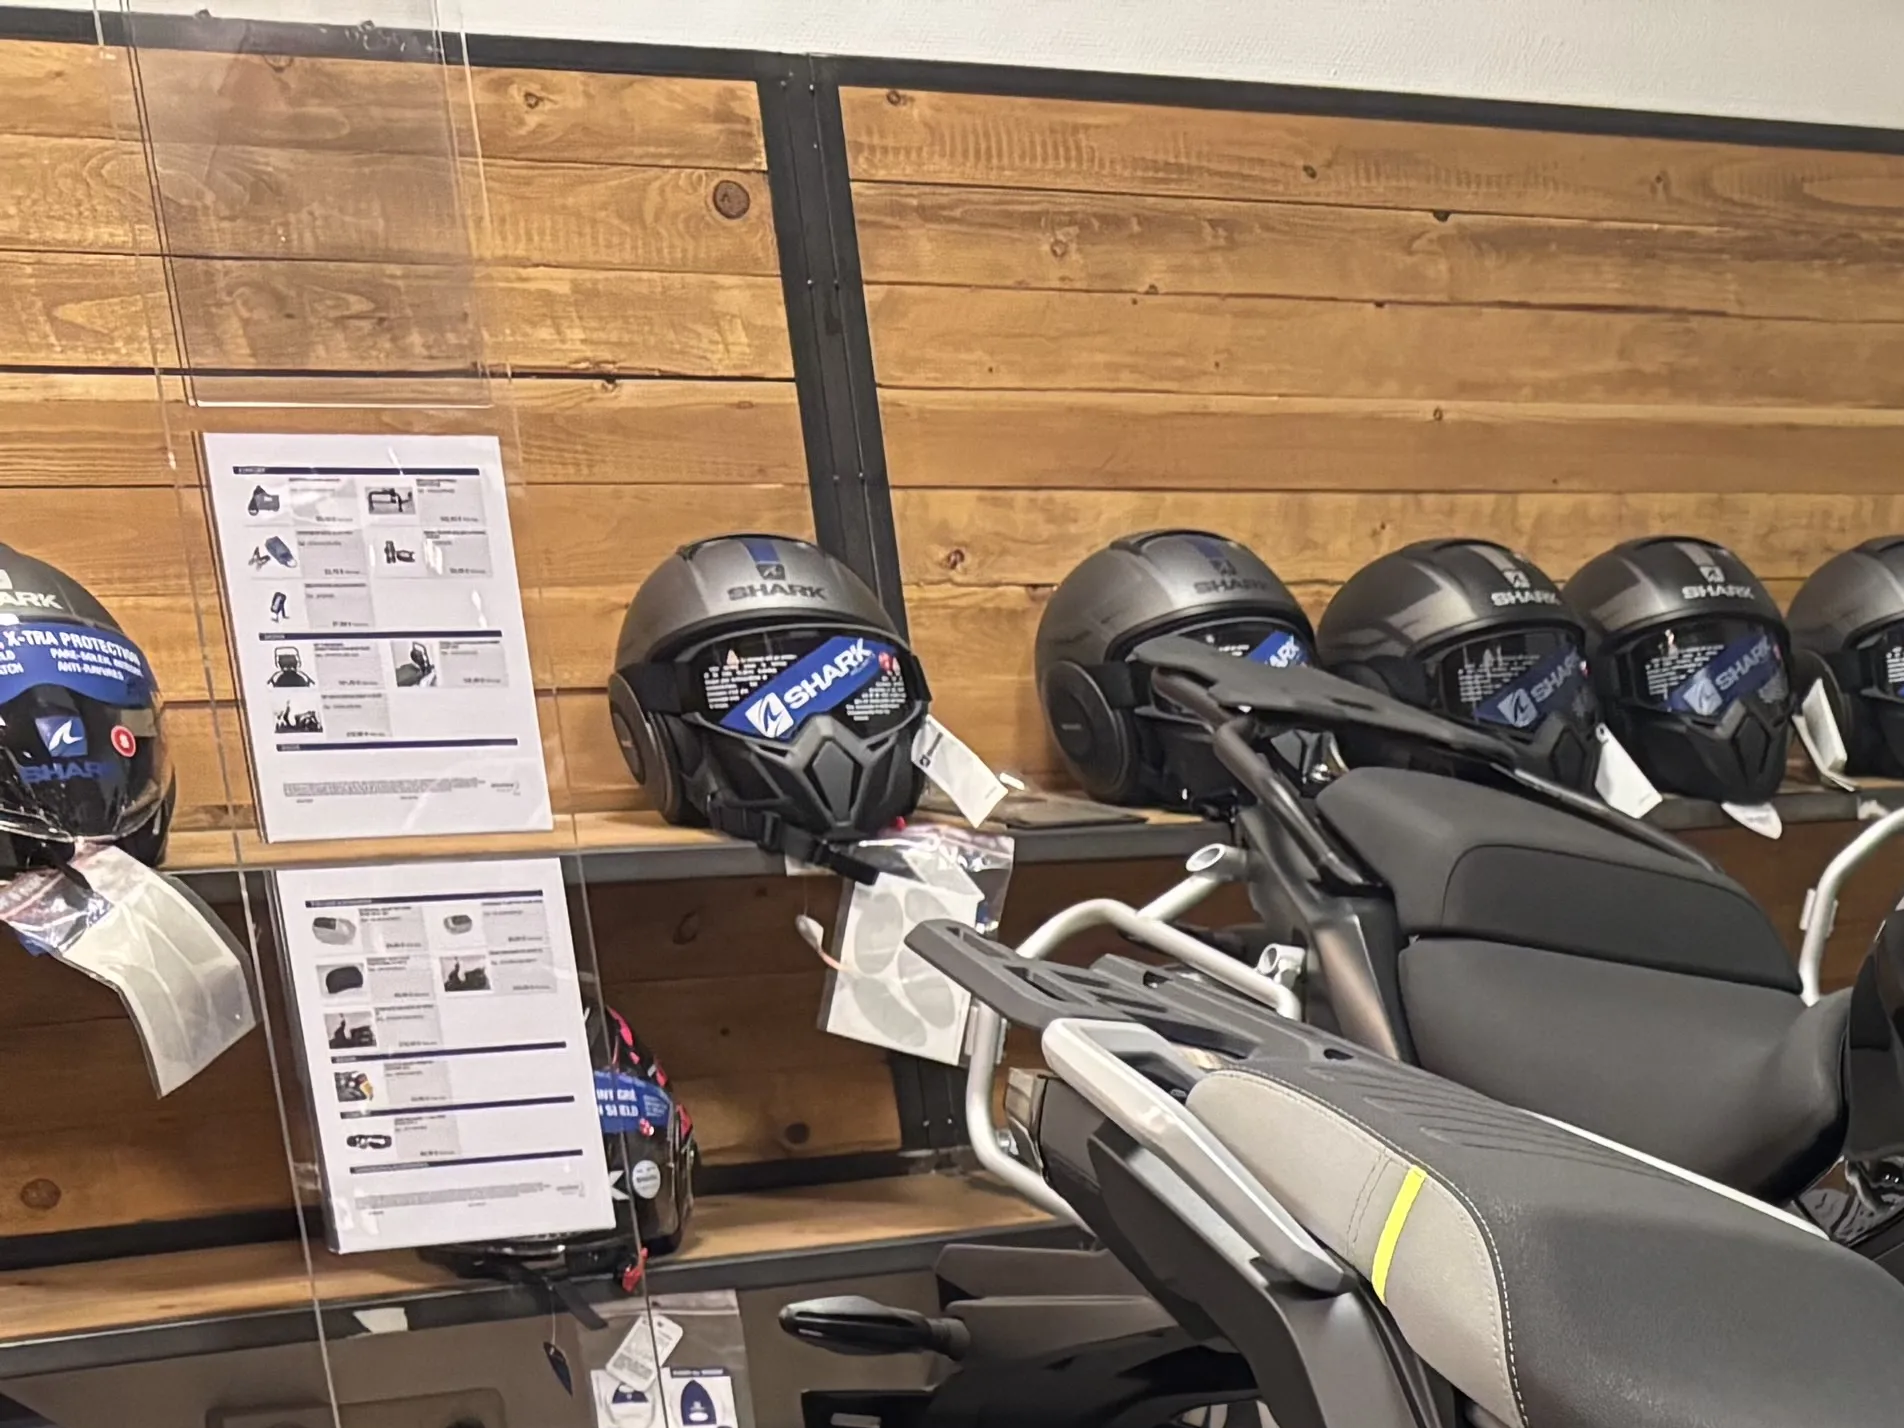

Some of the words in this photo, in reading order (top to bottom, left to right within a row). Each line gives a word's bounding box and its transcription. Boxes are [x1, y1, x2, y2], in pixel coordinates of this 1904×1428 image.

[727, 584, 826, 601] SHARK
[1490, 589, 1560, 608] SHARK
[1682, 584, 1755, 602] SHARK
[60, 631, 142, 667] PROTECTION
[783, 637, 873, 709] SHARK
[1714, 634, 1772, 693] SHARK
